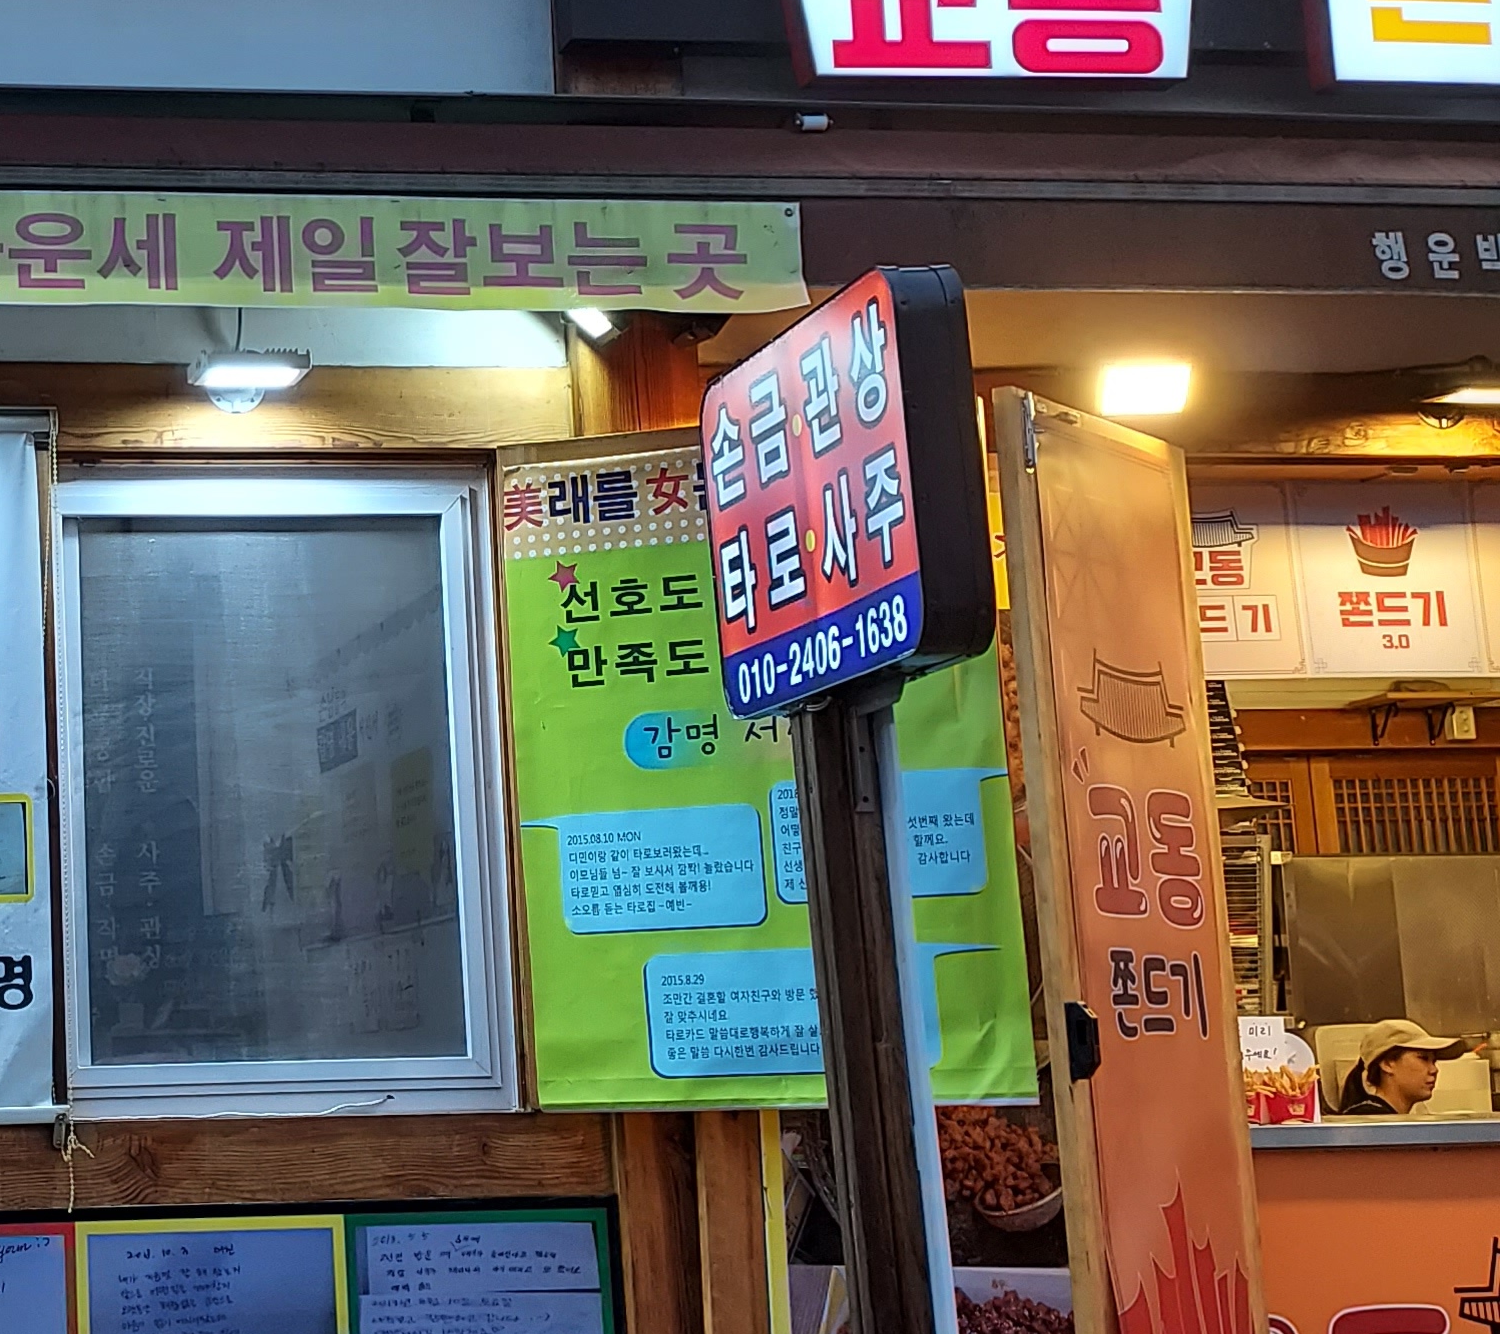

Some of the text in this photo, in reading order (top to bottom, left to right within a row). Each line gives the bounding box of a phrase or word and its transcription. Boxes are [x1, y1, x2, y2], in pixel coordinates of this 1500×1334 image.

[560, 574, 703, 624] 선호도
[1337, 590, 1448, 628] 쫀드기
[738, 595, 908, 704] 010-2406-1638
[1382, 633, 1411, 650] 3.0
[566, 639, 710, 689] 만족도
[643, 714, 719, 759] 감명
[942, 812, 975, 827] 왔는데
[918, 851, 971, 865] 감사합니다
[1088, 784, 1206, 931] 교동
[569, 868, 607, 882] 이모님들
[631, 865, 641, 879] 잘
[627, 899, 656, 914] 타로집
[661, 973, 705, 986] 2015.8.29
[663, 992, 692, 1005] 조만간
[730, 989, 782, 1004] 여자친구와
[785, 988, 806, 1002] 방문
[1108, 947, 1210, 1042] 쫀드기
[677, 1009, 728, 1024] 맞추시네요
[690, 1045, 710, 1060] 말씀
[714, 1043, 755, 1058] 다시한번
[758, 1042, 820, 1057] 감사드립니다
